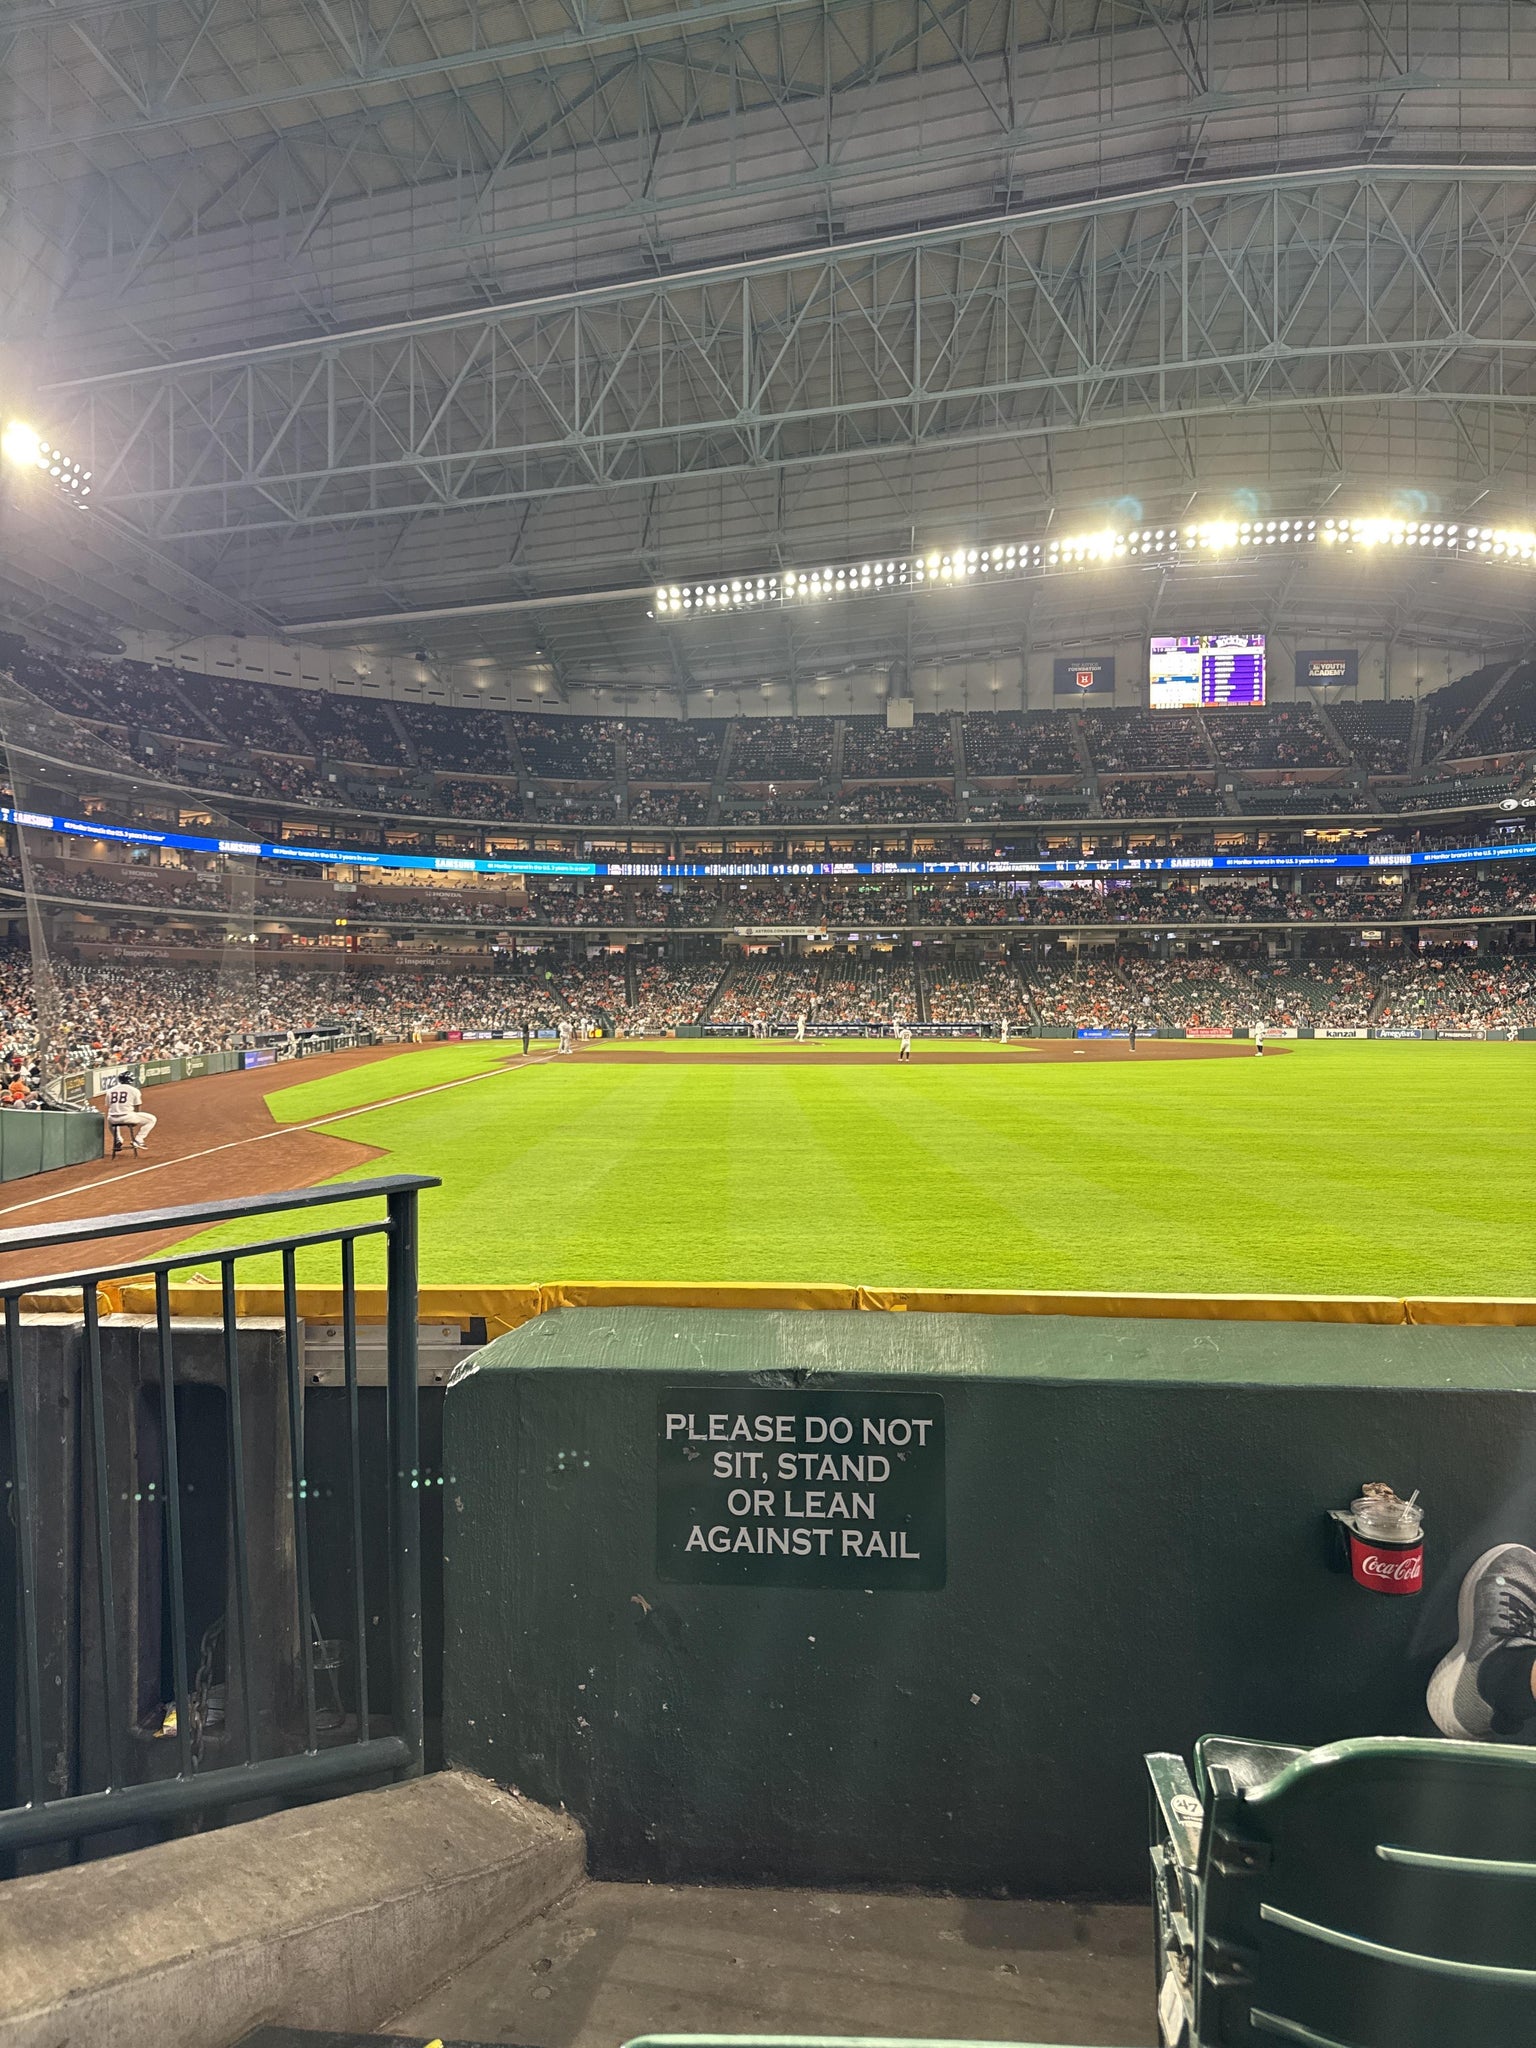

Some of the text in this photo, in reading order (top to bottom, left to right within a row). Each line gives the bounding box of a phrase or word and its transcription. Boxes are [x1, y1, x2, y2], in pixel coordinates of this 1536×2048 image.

[218, 841, 261, 854] SAMSUNG
[435, 859, 476, 869] SAMSUNG
[1171, 858, 1213, 867] SAMSUNG
[1369, 856, 1411, 864] SAMSUNG
[972, 862, 978, 872] K
[129, 870, 158, 878] HONDA
[666, 1414, 933, 1446] PLEASE DO NOT
[713, 1452, 890, 1484] SIT, STAND
[727, 1489, 875, 1520] OR LEAN
[685, 1525, 920, 1560] AGAINST RAIL
[1362, 1554, 1422, 1581] Coca-Cola
